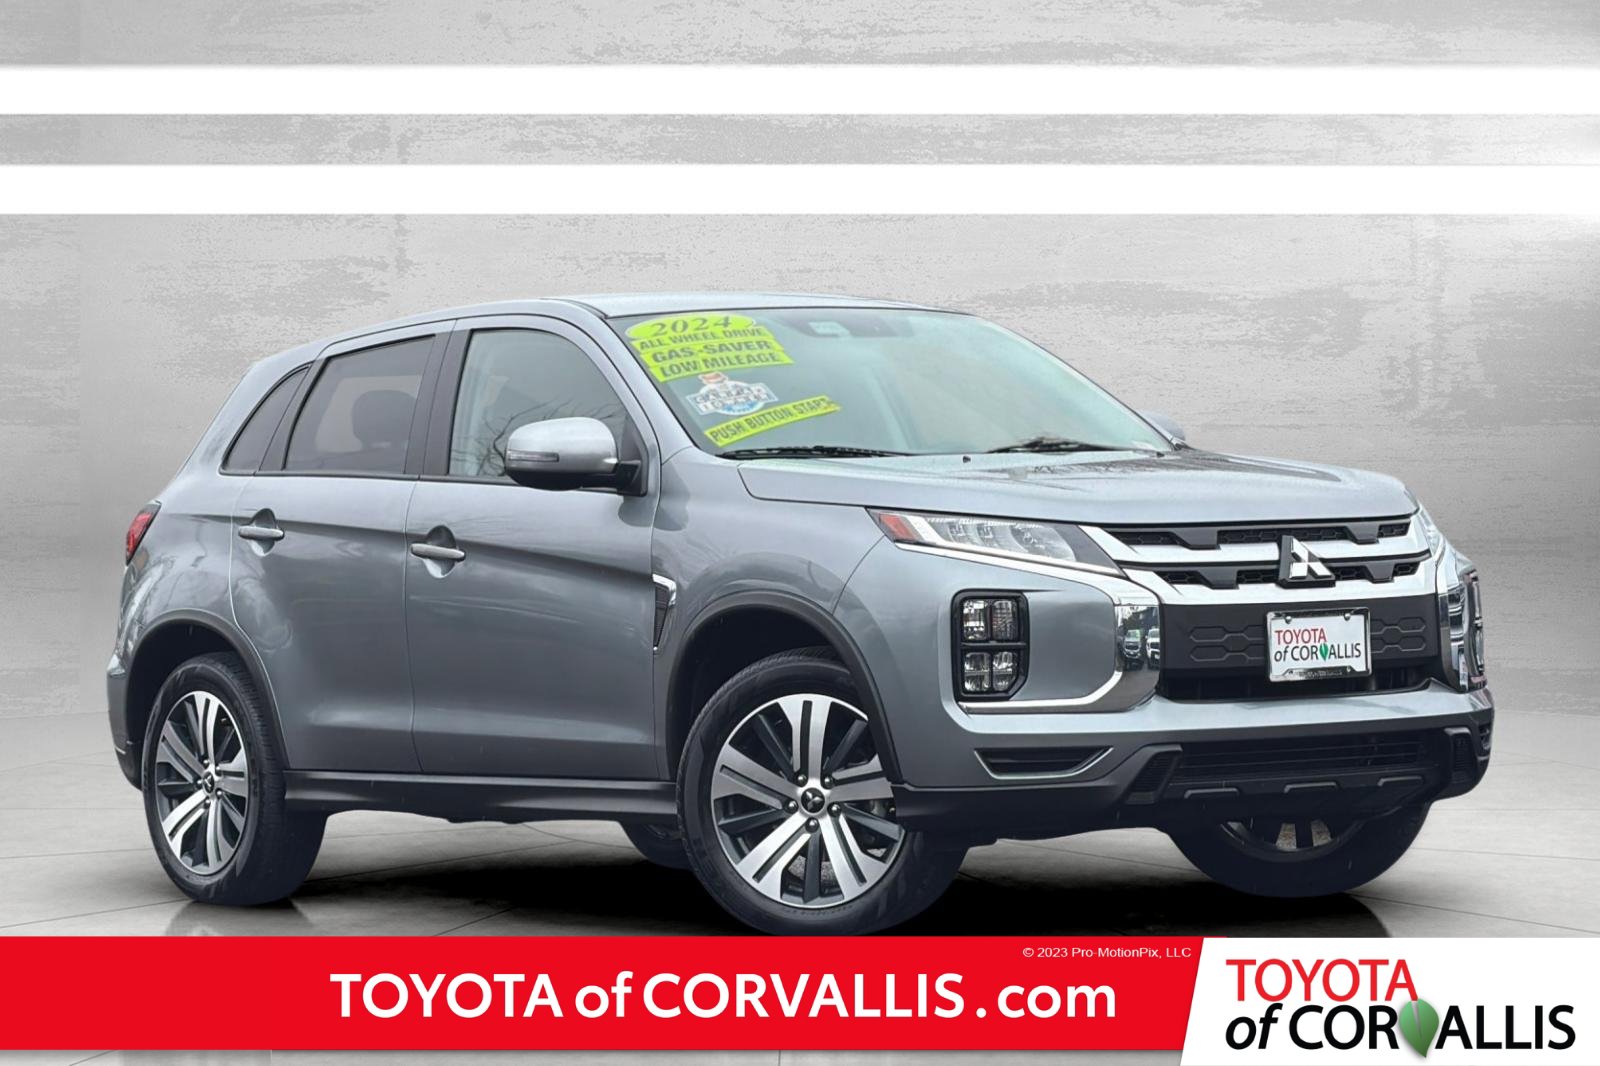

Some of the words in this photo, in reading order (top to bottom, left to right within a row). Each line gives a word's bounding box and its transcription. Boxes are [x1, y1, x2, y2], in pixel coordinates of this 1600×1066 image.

[648, 316, 732, 336] 2024
[640, 338, 667, 351] ALL
[668, 331, 721, 345] WHEEL
[722, 327, 765, 338] DRIVE
[660, 361, 699, 378] LOW
[703, 351, 781, 369] MILEAGE
[709, 422, 746, 442] PUSH
[745, 407, 794, 429] BUTTON
[1274, 628, 1327, 645] TOYOTA
[1274, 645, 1290, 662] of
